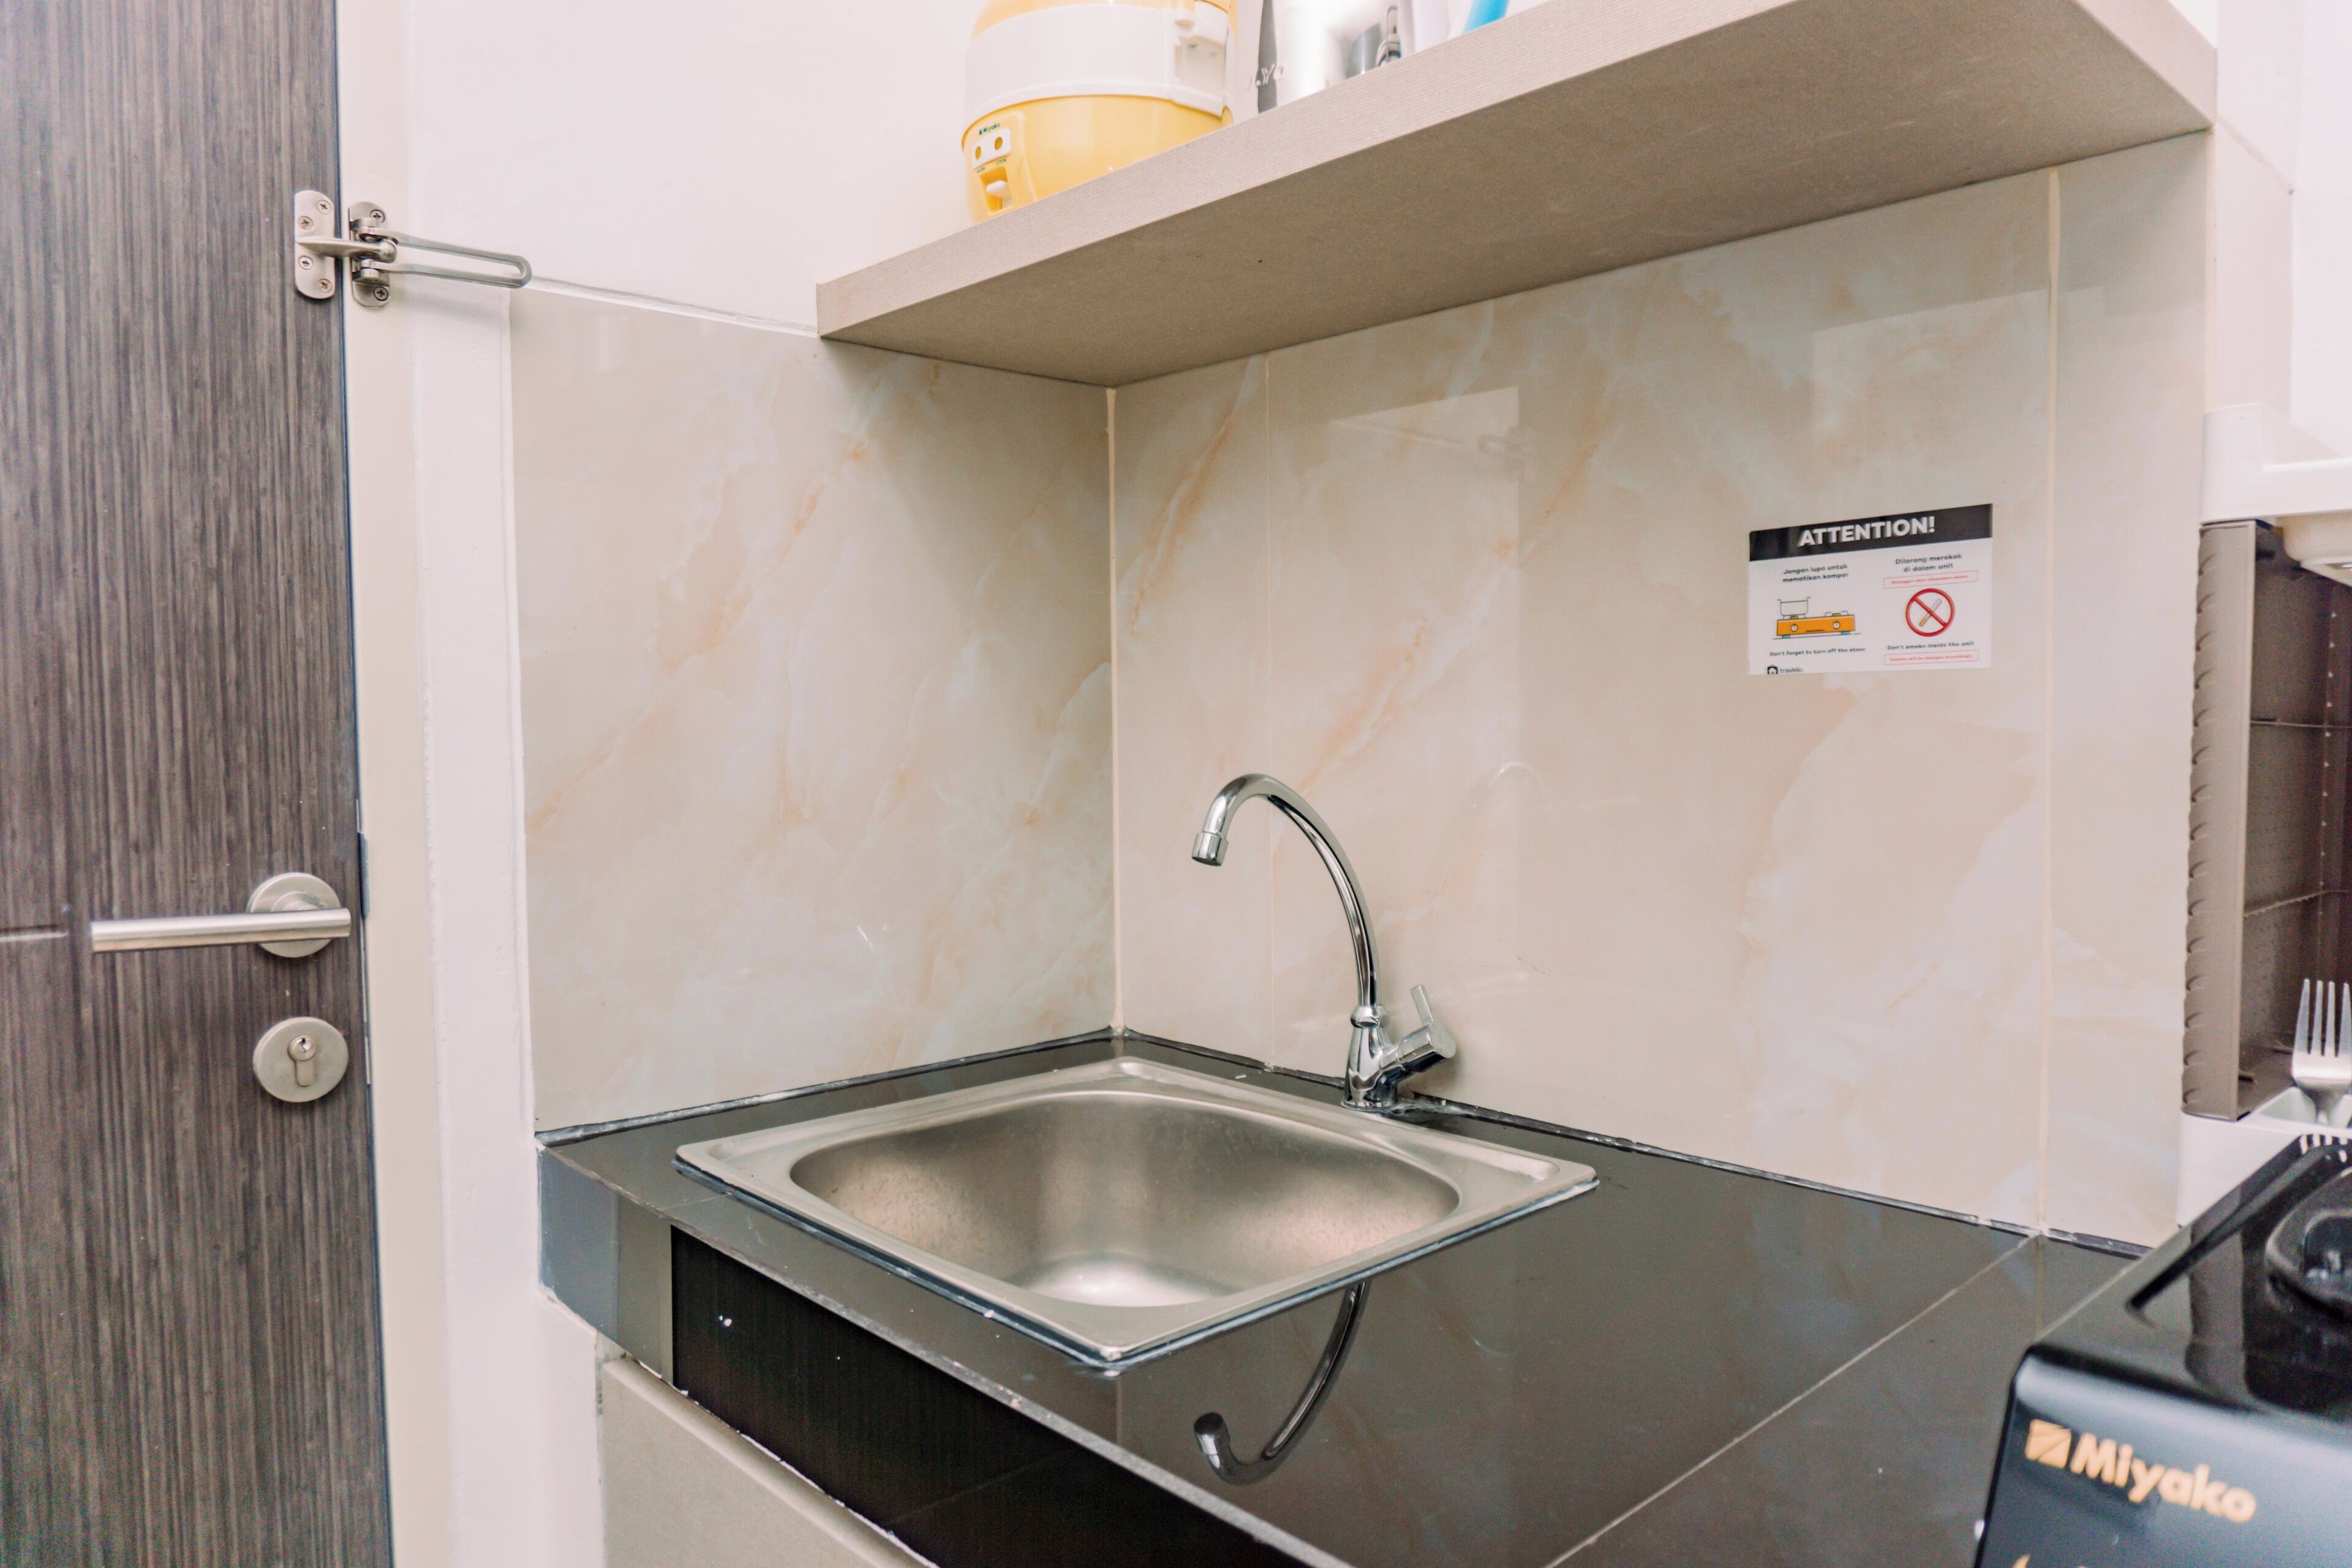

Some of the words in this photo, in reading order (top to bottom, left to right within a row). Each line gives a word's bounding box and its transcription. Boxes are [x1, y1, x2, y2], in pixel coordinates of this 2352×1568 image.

[982, 123, 1001, 133] Miyako
[1798, 516, 1935, 547] ATTENTION!
[2070, 1432, 2258, 1524] Miyako
